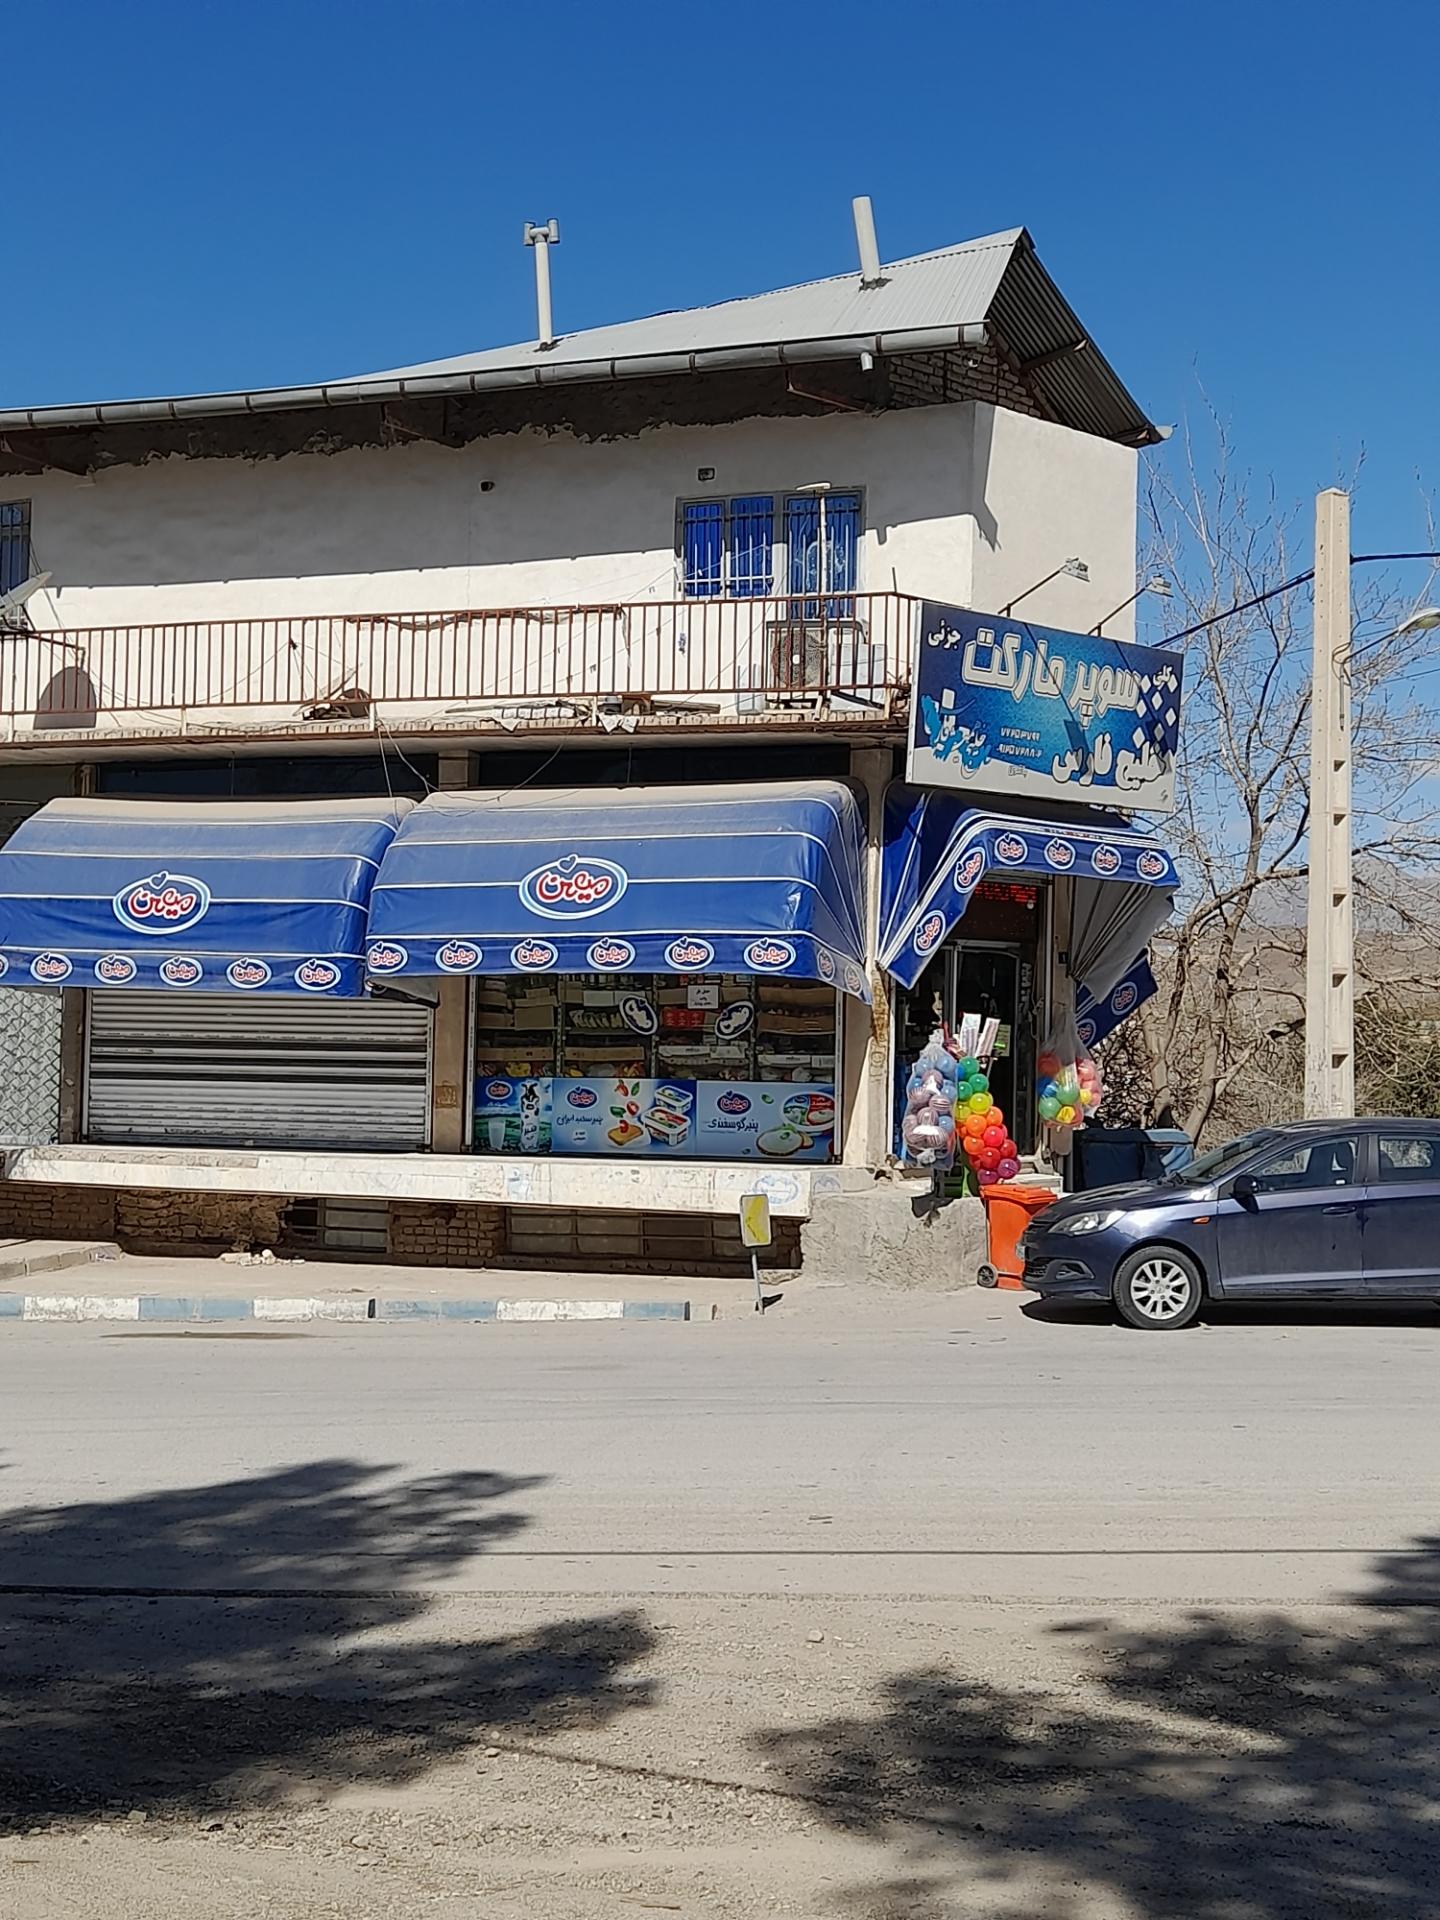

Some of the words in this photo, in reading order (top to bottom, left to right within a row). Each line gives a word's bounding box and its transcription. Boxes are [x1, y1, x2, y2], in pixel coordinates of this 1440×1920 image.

[962, 628, 1067, 704] مارکت
[1068, 660, 1142, 730] سوپر
[1052, 730, 1113, 788] فارس
[1115, 740, 1166, 791] خلیج
[536, 870, 611, 903] میهن
[127, 886, 197, 920] میهن
[369, 952, 402, 968] میهن
[442, 949, 475, 965] میهن
[517, 946, 552, 964] میهن
[596, 946, 629, 962] میهن
[671, 945, 708, 963] میهن
[751, 946, 790, 964] میهن
[36, 960, 69, 976] میهن
[101, 962, 132, 977] میهن
[165, 963, 197, 980] میهن
[232, 966, 266, 981] میهن
[301, 967, 334, 982] میهن
[744, 1119, 759, 1133] پنیر
